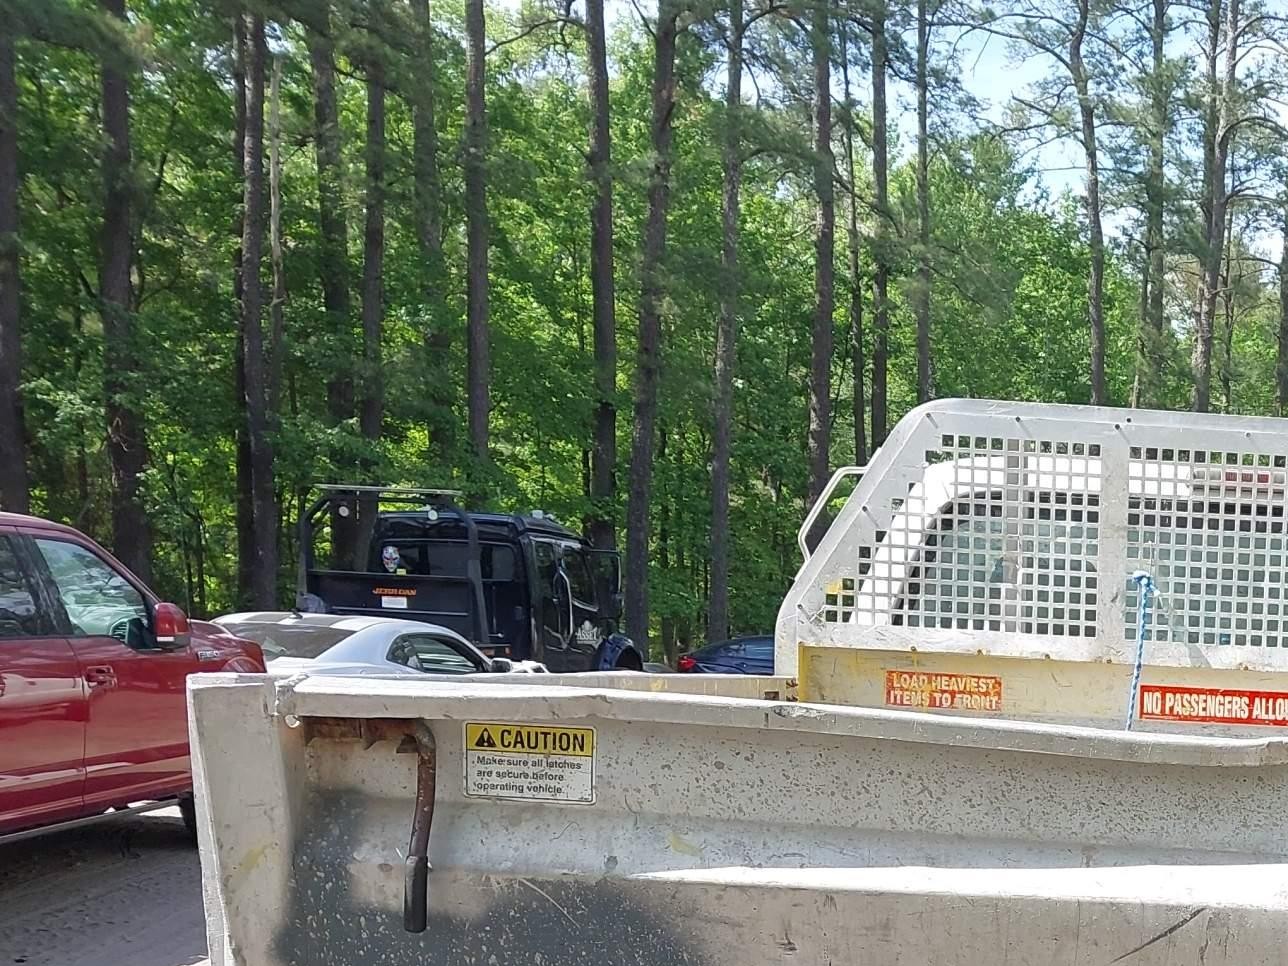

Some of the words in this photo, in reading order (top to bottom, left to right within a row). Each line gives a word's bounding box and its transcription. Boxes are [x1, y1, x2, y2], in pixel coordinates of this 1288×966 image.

[892, 672, 928, 690] LOAD
[931, 675, 996, 693] HEAVIEST
[889, 689, 930, 707] ITEMS
[933, 692, 952, 708] TO
[953, 693, 999, 711] FRONT
[1143, 691, 1162, 714] NO
[1165, 692, 1250, 719] PASSENGERS
[500, 729, 585, 752] CAUTION
[476, 755, 504, 765] Make
[506, 758, 529, 767] sure
[531, 758, 544, 767] all
[546, 759, 582, 770] latches
[476, 769, 493, 778] are
[495, 769, 530, 780] secure
[532, 771, 565, 782] before
[476, 781, 525, 794] operating
